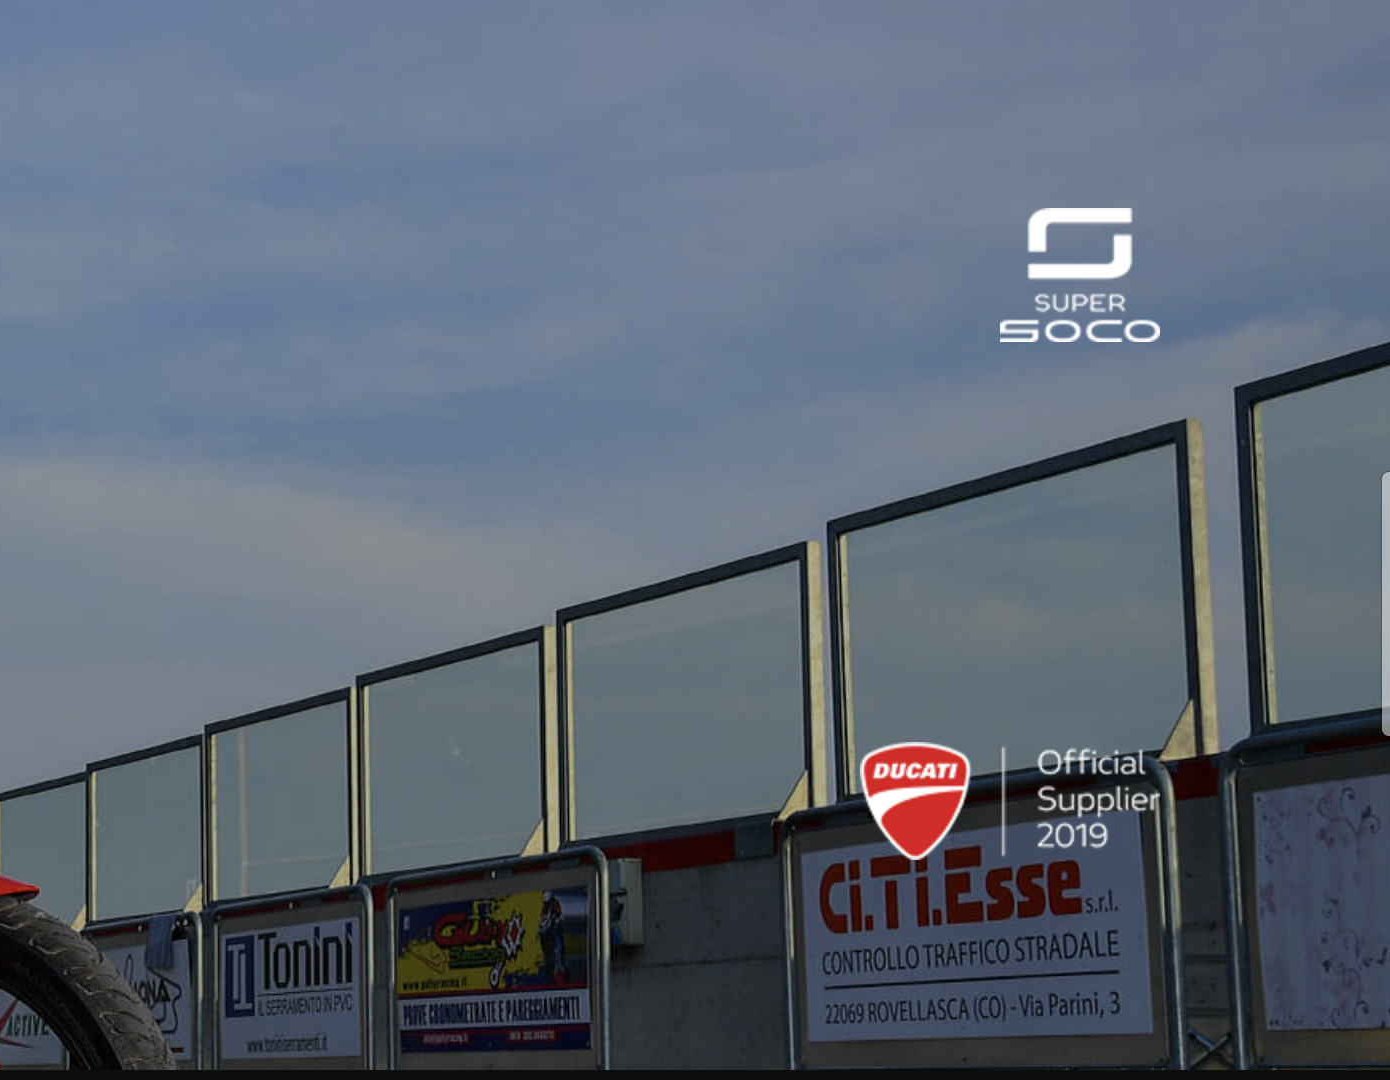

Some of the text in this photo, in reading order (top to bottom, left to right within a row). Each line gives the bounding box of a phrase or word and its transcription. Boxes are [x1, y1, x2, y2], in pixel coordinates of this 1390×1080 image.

[1085, 888, 1120, 914] s.r.l.
[258, 921, 353, 990] Tonini
[822, 929, 1120, 975] CONTROLLO TRAFFICO STRADALE
[266, 996, 321, 1016] SERRAMENTO
[333, 993, 353, 1012] PVC
[498, 1001, 505, 1022] E
[825, 1002, 865, 1025] 22069
[867, 998, 970, 1023] ROVELLASCA
[973, 996, 1007, 1021] (CO)
[1018, 994, 1044, 1018] Via
[1049, 992, 1104, 1018] Parini,
[1110, 991, 1121, 1015] 3
